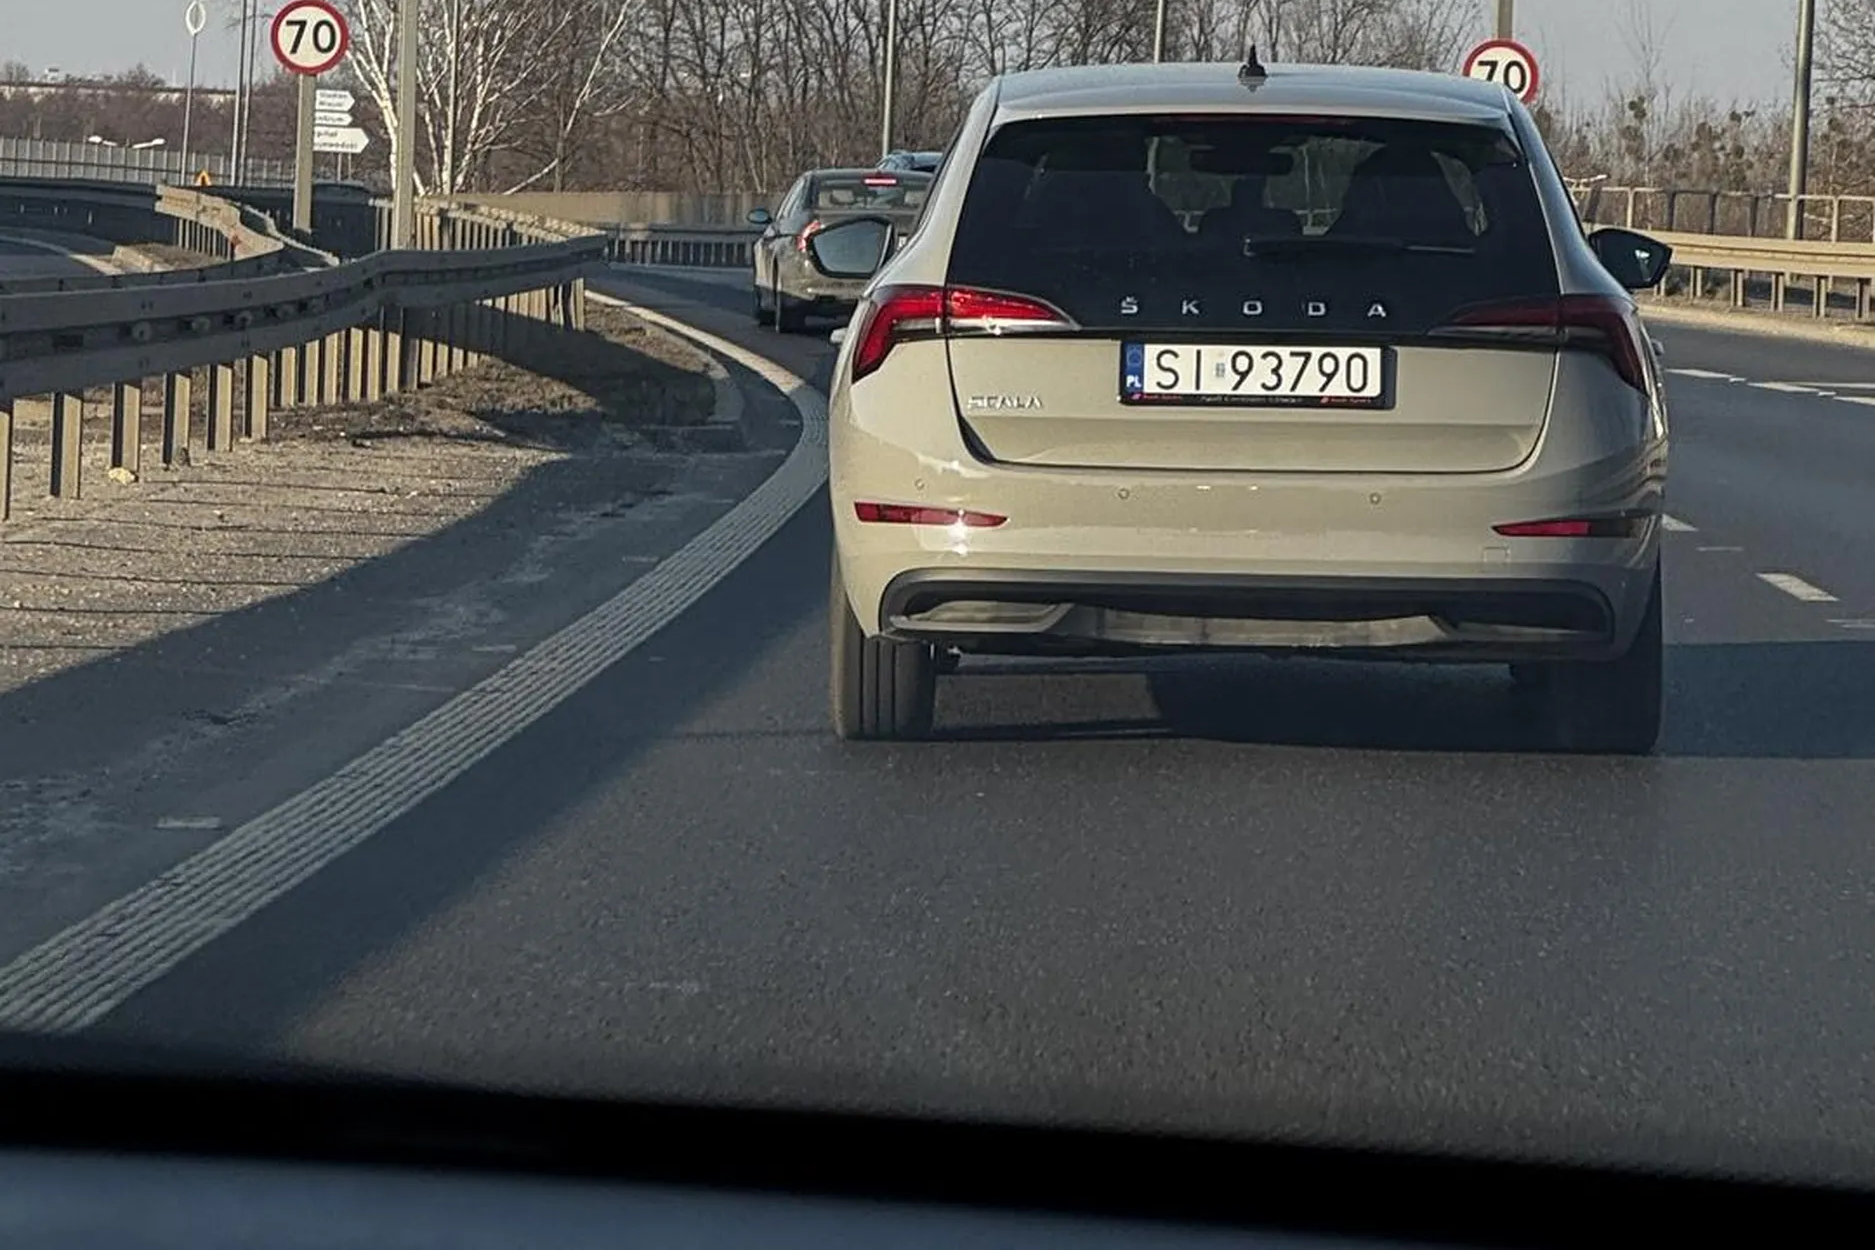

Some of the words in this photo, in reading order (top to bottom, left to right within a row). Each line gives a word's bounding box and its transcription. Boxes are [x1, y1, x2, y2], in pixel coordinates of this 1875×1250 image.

[285, 19, 337, 54] 70
[1477, 60, 1527, 94] 70
[1121, 296, 1386, 317] ŠKODA
[1125, 374, 1143, 388] PL
[1155, 348, 1202, 391] SI
[1230, 350, 1368, 392] 93790
[967, 395, 1044, 410] SCALA
